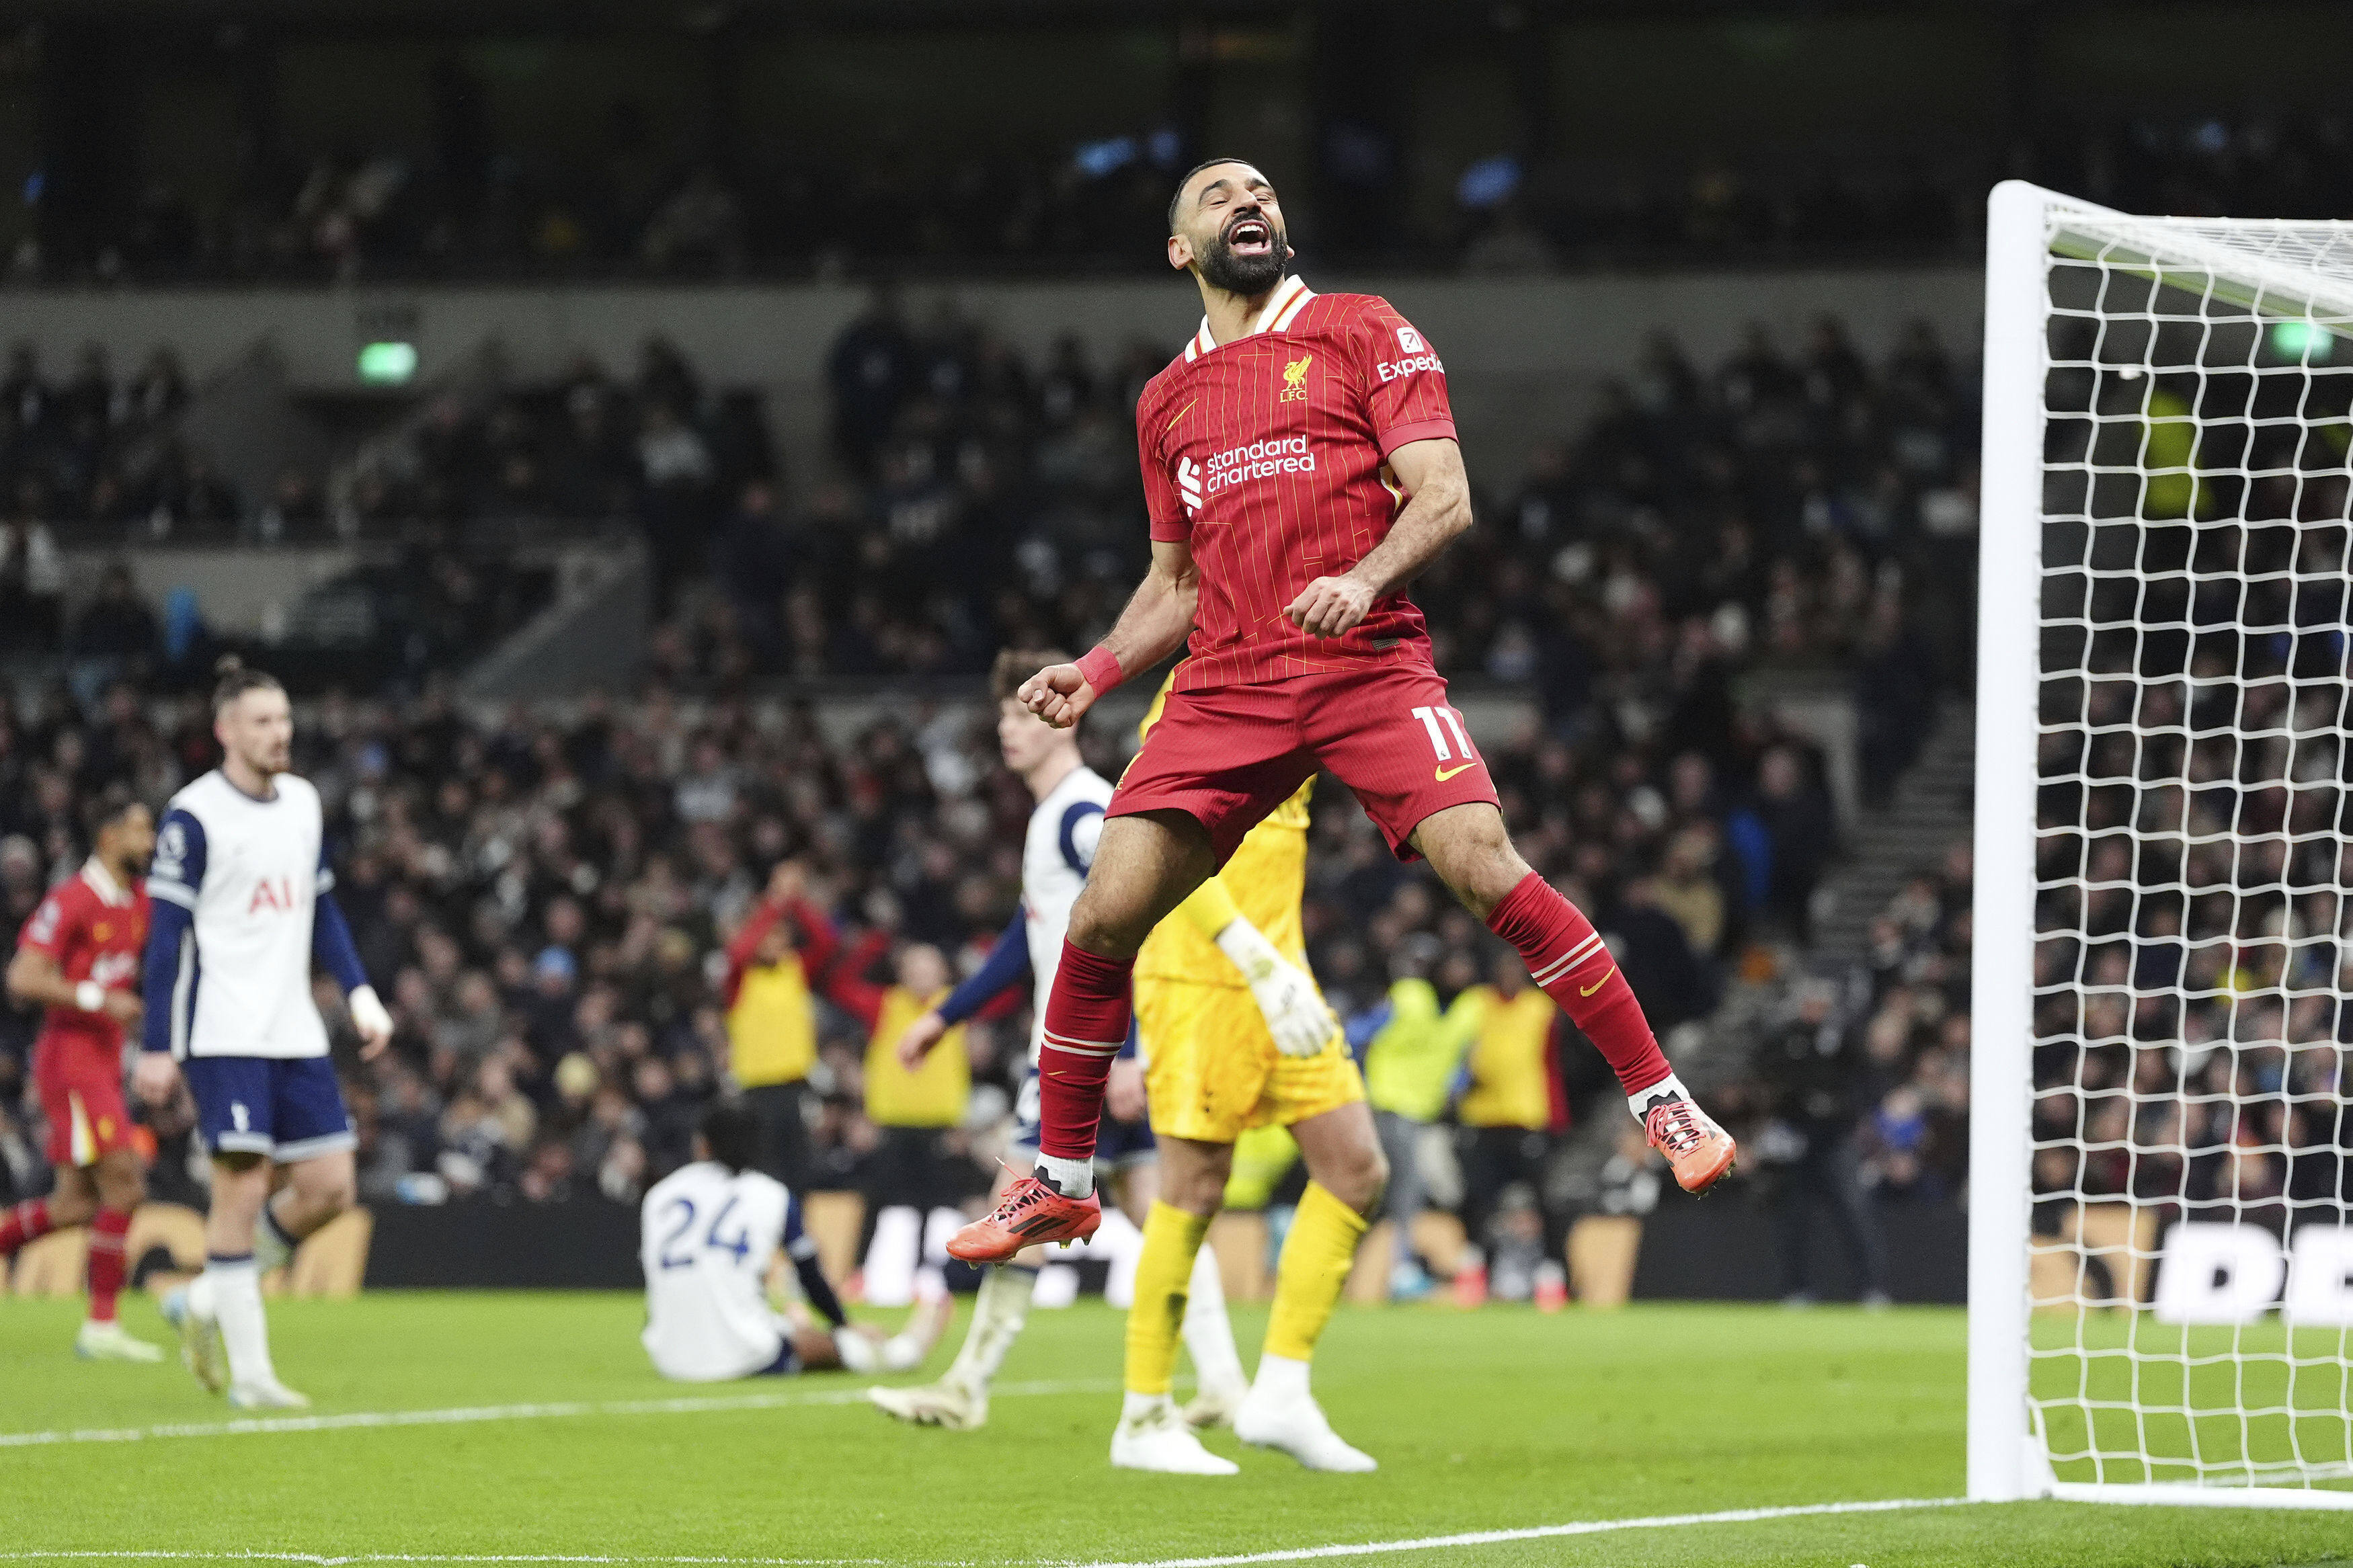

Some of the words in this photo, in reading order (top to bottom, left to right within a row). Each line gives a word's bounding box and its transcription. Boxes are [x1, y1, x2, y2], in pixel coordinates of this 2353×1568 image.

[1207, 434, 1306, 474] standard
[1207, 452, 1316, 493] chartered
[1410, 706, 1473, 761] 11
[659, 1195, 749, 1269] 24
